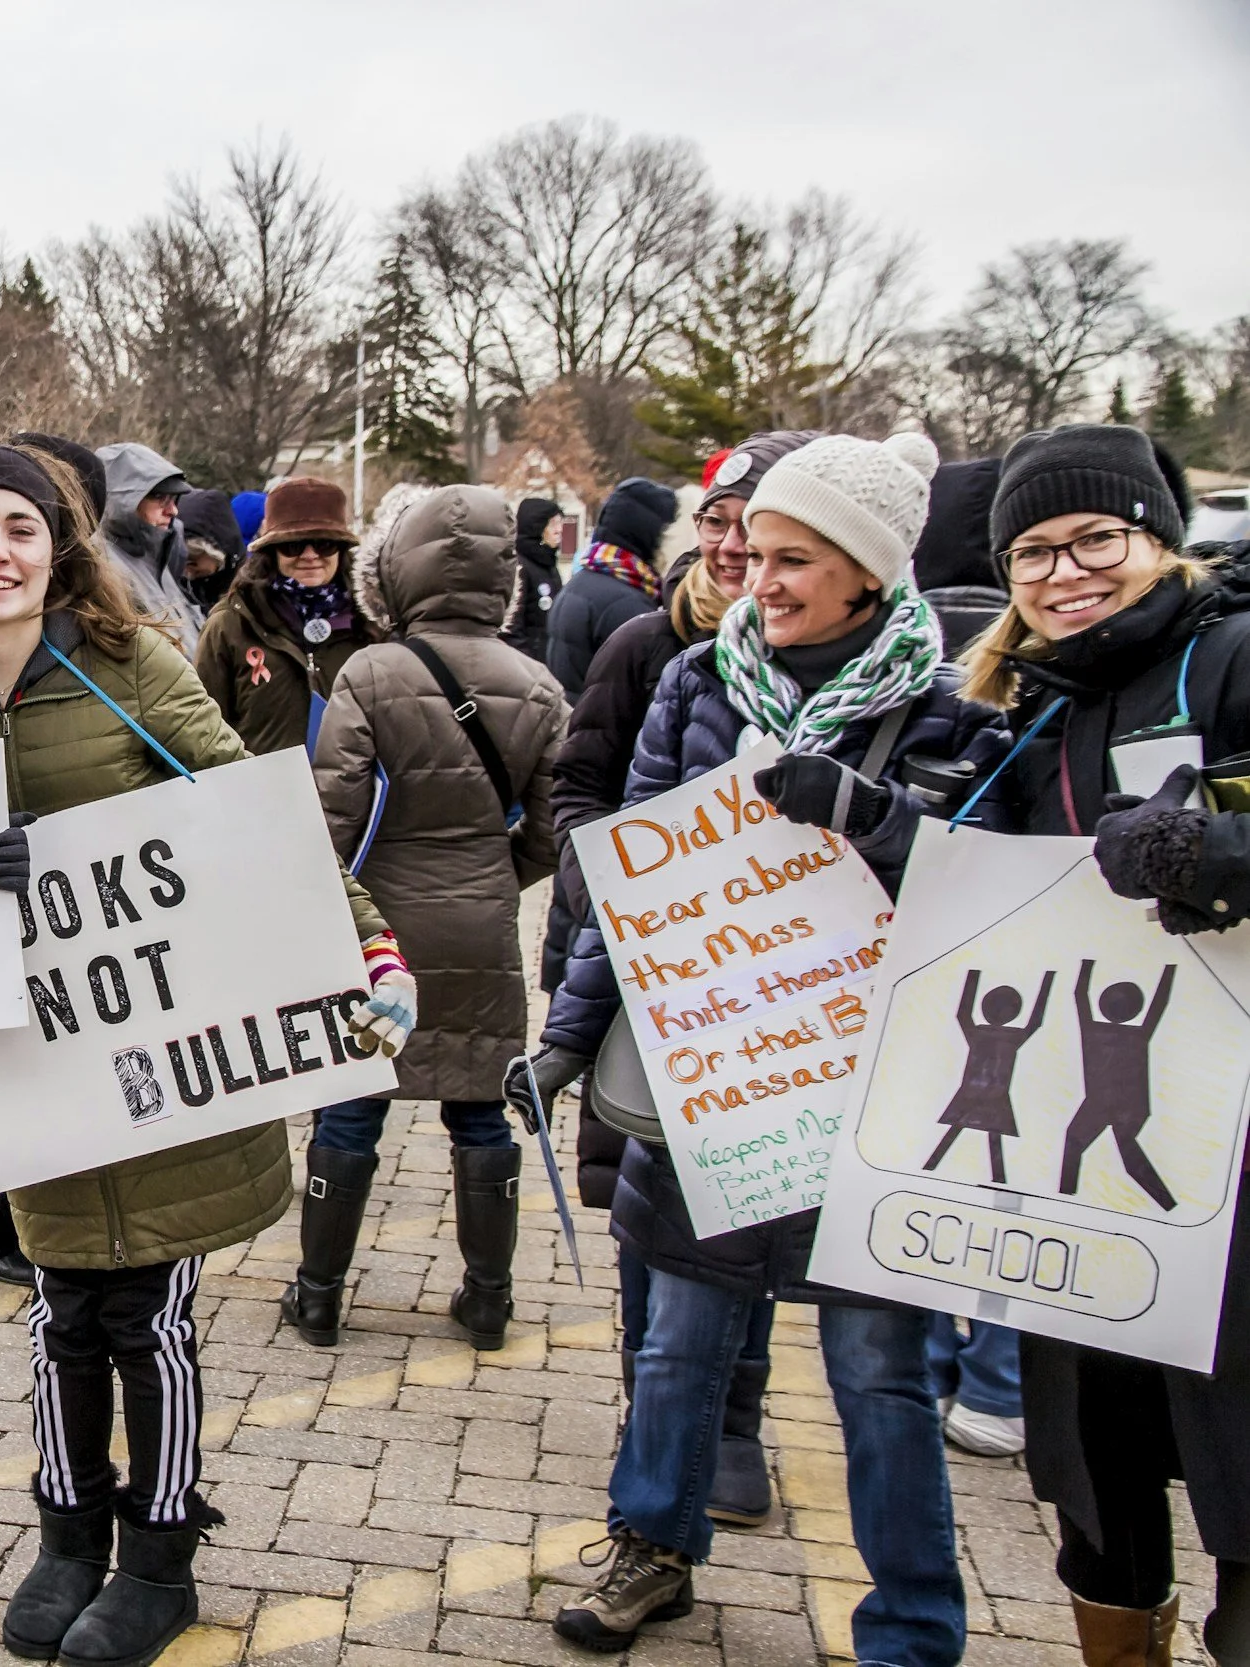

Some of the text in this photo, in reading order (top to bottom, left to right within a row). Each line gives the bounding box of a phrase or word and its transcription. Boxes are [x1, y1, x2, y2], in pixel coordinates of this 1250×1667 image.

[610, 805, 724, 879] Did
[602, 828, 845, 942] hear about
[26, 940, 174, 1042] NOT
[622, 917, 815, 991] the Mass
[647, 987, 751, 1039] Knife
[112, 987, 379, 1121] BULLETS
[664, 1046, 725, 1085] Or
[736, 1016, 823, 1064] that
[689, 1109, 843, 1170] Weapons Ma
[724, 1185, 777, 1210] Limit
[901, 1210, 1094, 1299] SCHOOL
